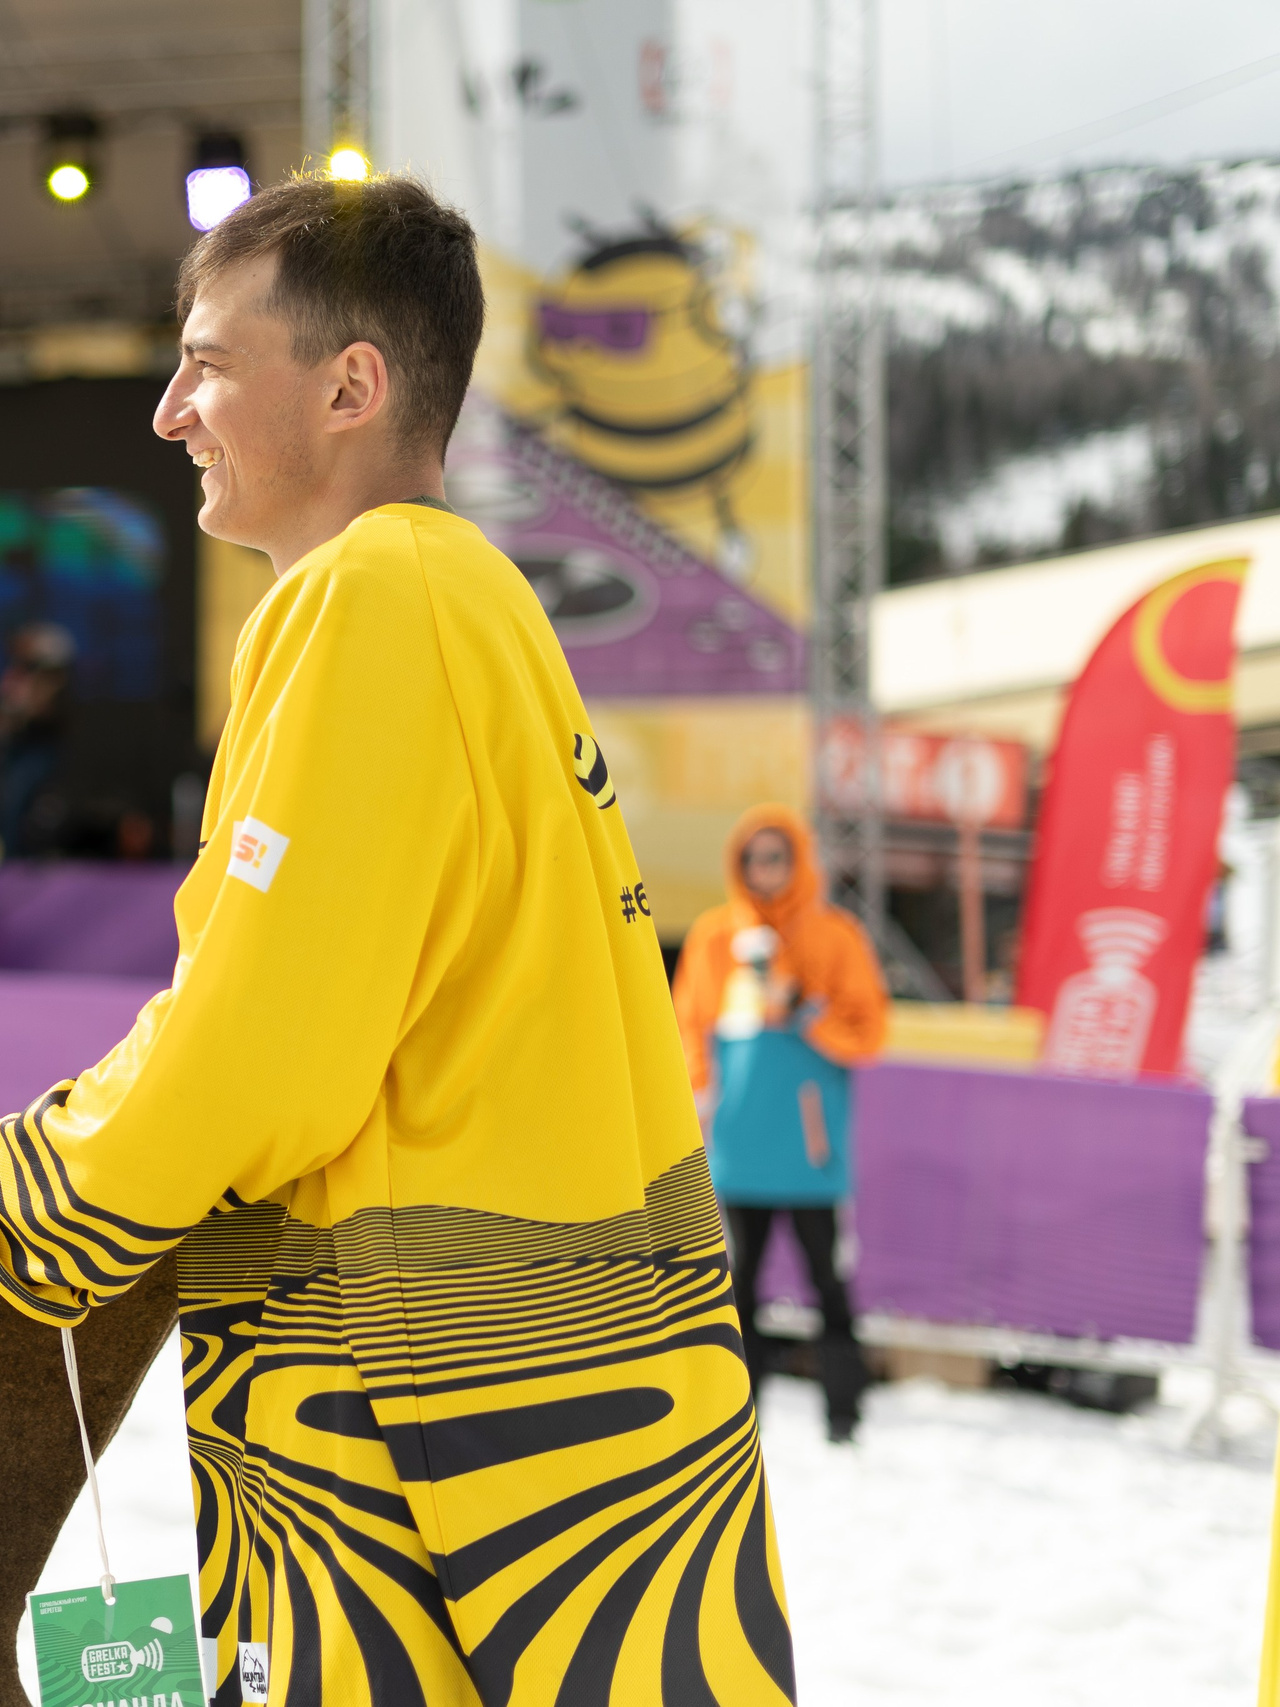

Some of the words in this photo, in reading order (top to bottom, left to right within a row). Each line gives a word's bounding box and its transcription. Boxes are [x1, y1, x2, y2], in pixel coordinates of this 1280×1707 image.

[39, 1605, 62, 1615] ШЕРЕГЕШ
[89, 1646, 128, 1663] GRELKA
[90, 1661, 117, 1677] FEST
